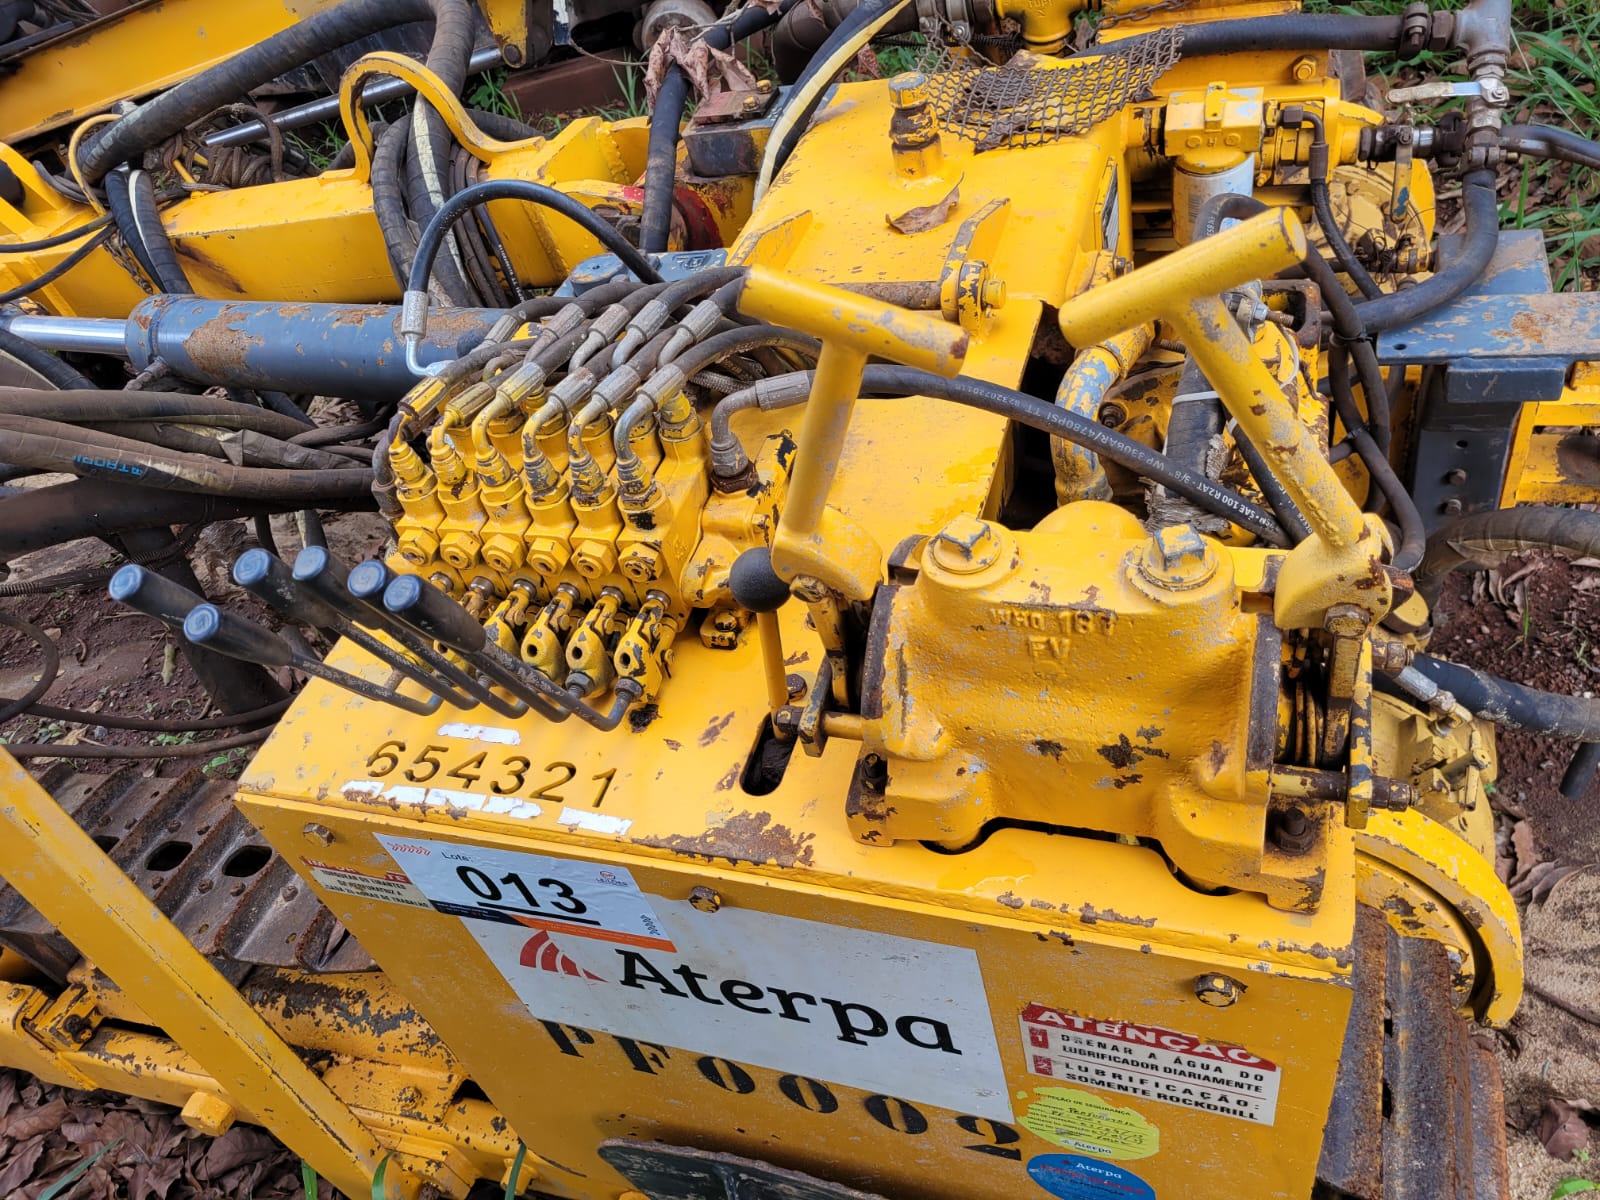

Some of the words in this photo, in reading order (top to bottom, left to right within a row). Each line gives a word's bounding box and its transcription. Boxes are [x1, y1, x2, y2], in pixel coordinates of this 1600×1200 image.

[1196, 480, 1222, 499] R2AT
[1221, 494, 1241, 509] 100
[1238, 505, 1256, 519] SAE
[441, 851, 474, 863] Lote:
[456, 865, 587, 914] 013
[615, 948, 963, 1056] Aterpa
[1148, 1052, 1157, 1060] A
[1173, 1056, 1223, 1073] ÁGUA
[1240, 1071, 1264, 1082] DO
[1163, 1066, 1263, 1093] DIARIAMENTE
[1066, 1073, 1152, 1097] SOMENTE
[1157, 1092, 1258, 1120] ROCKDRILL
[1075, 1162, 1123, 1180] Aterpa
